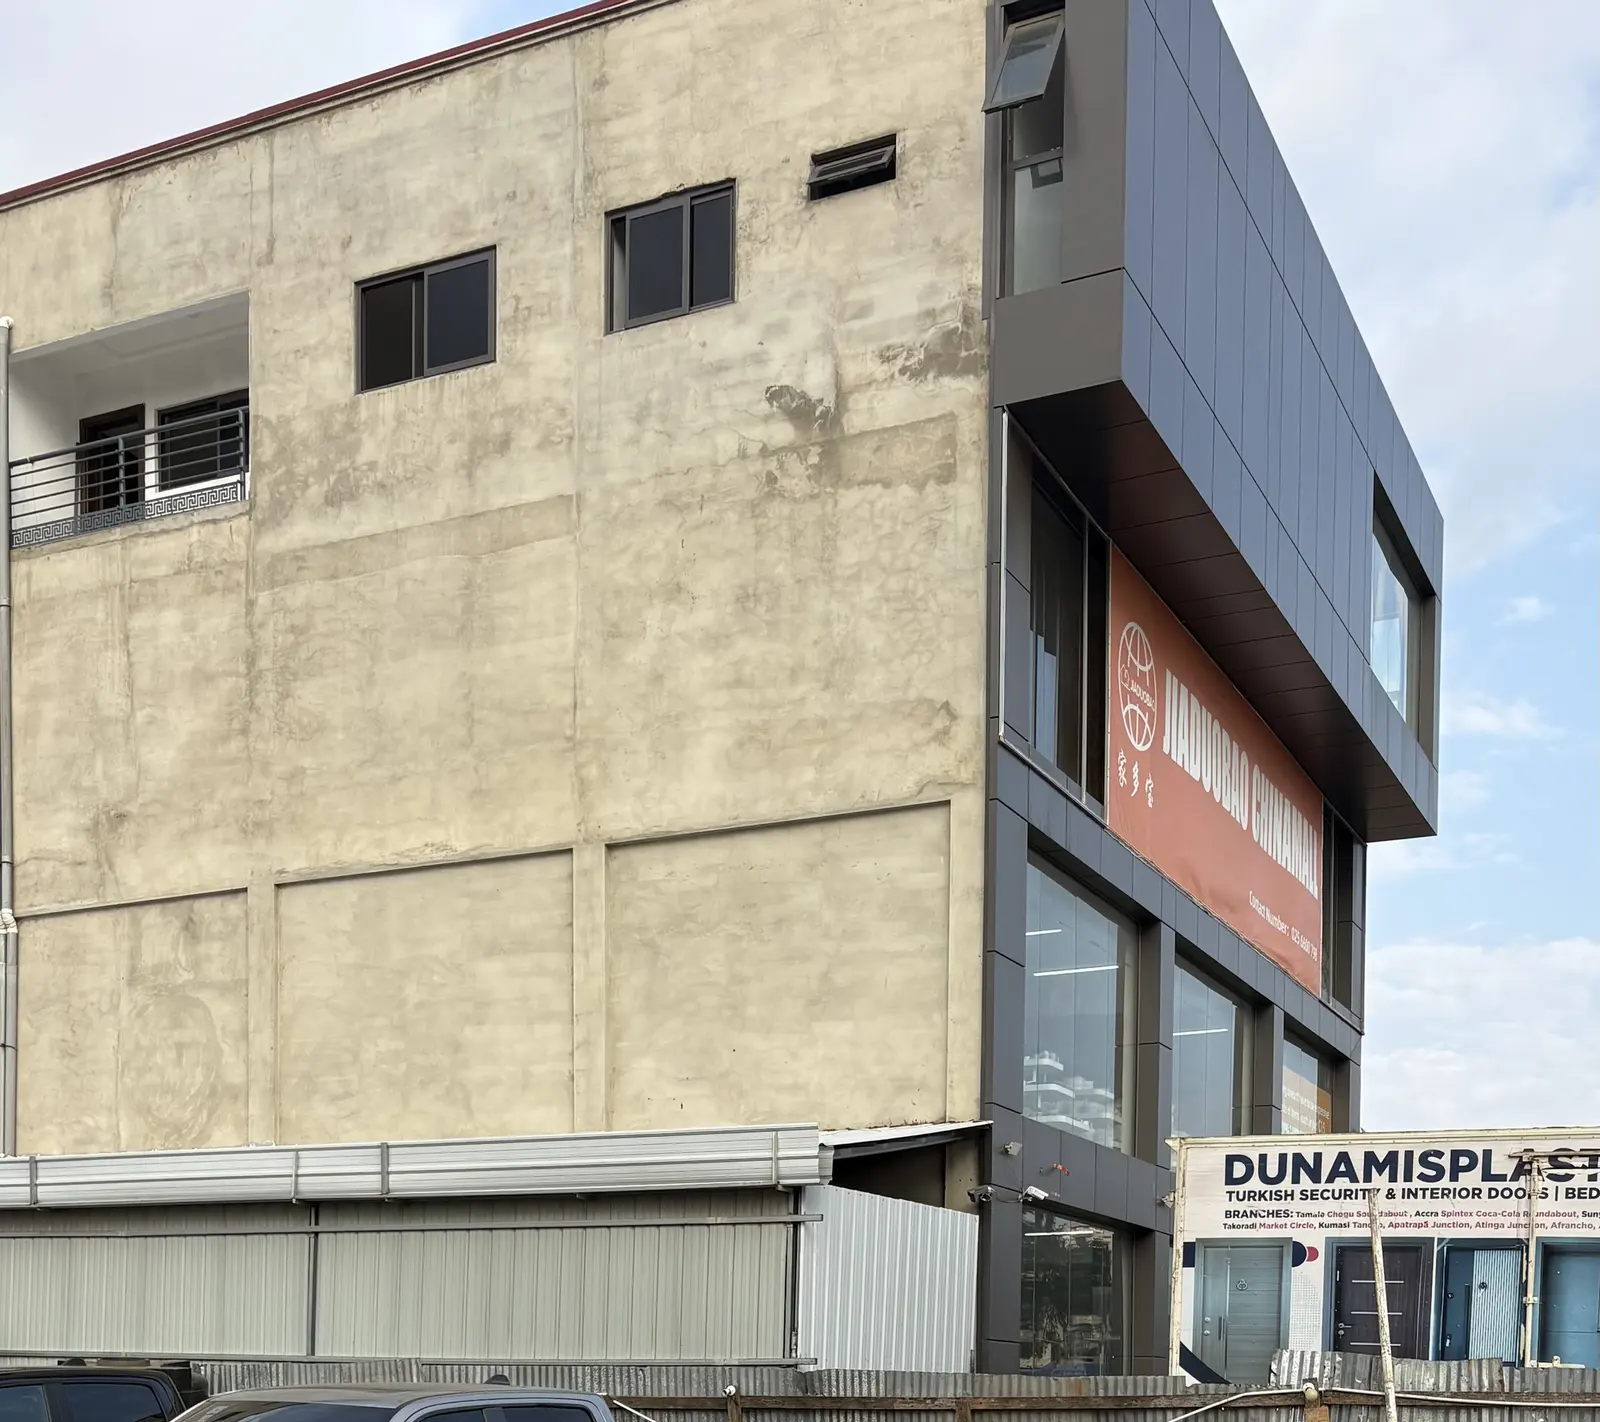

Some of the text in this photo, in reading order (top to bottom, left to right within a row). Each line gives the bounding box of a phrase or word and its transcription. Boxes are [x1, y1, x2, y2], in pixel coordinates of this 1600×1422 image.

[1163, 668, 1319, 900] JIADUOBAO CHINAMALL
[1249, 890, 1266, 920] Contact
[1266, 906, 1290, 937] Number:
[1226, 1189, 1295, 1202] TURKISH
[1385, 1187, 1397, 1200] &
[1401, 1187, 1483, 1200] INTERIOR
[1487, 1187, 1549, 1200] DOOS
[1564, 1187, 1600, 1200] BED
[1224, 1208, 1294, 1219] BRANCHES:
[1327, 1210, 1355, 1219] Chogu
[1414, 1210, 1439, 1218] Accra
[1441, 1210, 1474, 1219] Spintex
[1475, 1210, 1521, 1218] Coca-Cola
[1222, 1222, 1257, 1230] Takoradi
[1259, 1222, 1288, 1230] Market
[1289, 1221, 1317, 1230] Circle,
[1318, 1221, 1350, 1229] Kumasi
[1431, 1221, 1473, 1229] Junction,
[1475, 1221, 1505, 1230] Atinga
[1507, 1221, 1548, 1230] Juncon,
[1551, 1221, 1596, 1230] Afrancho,
